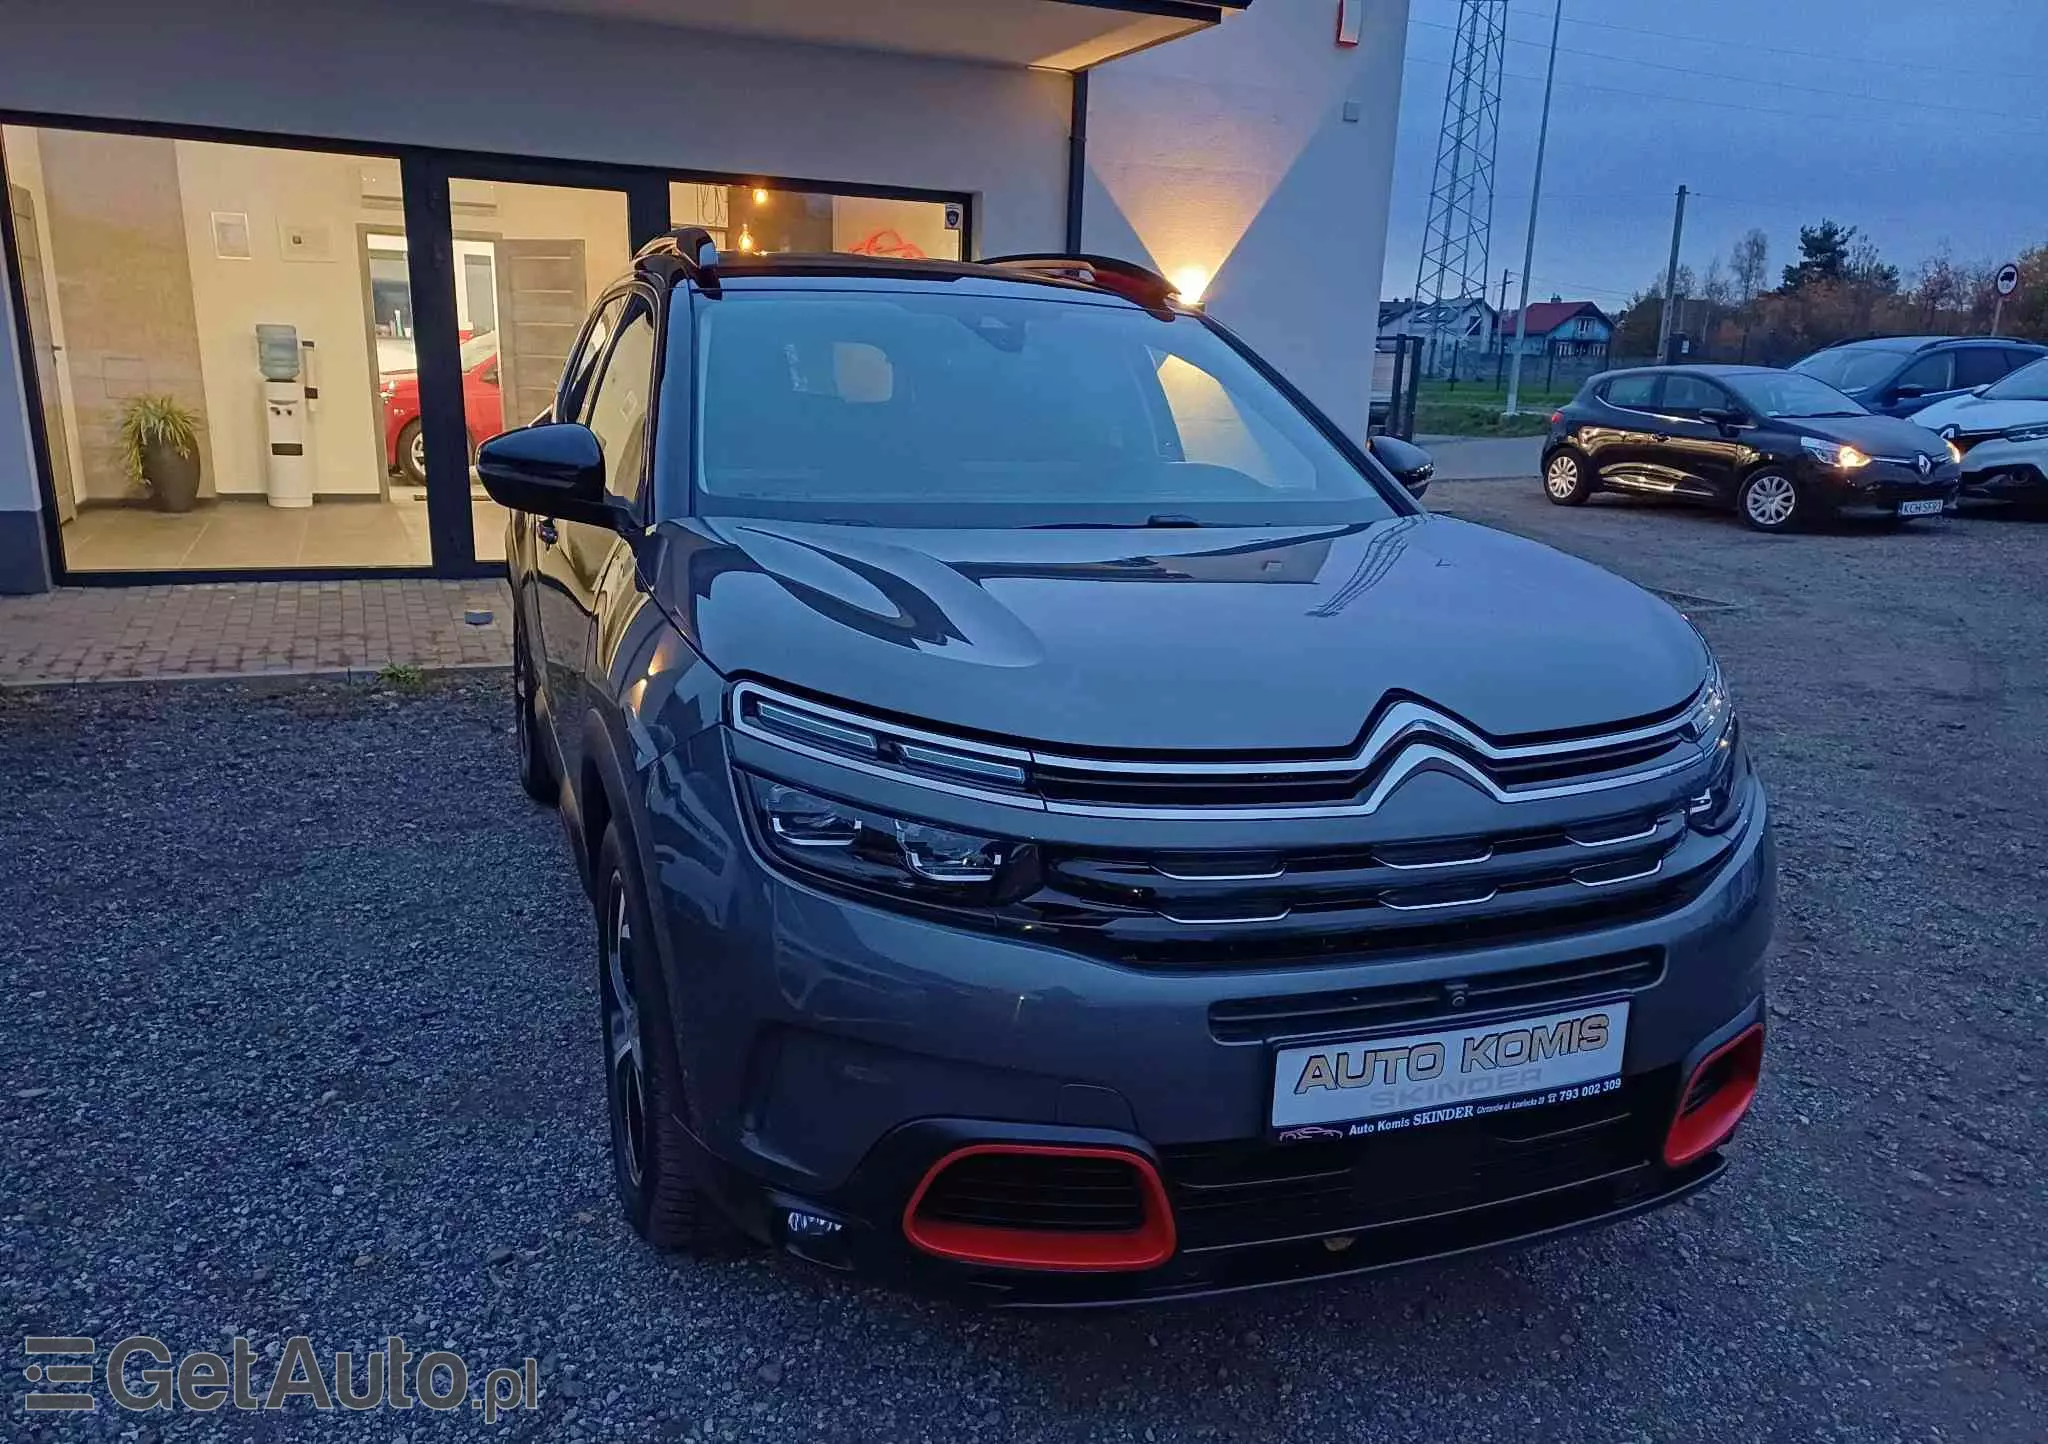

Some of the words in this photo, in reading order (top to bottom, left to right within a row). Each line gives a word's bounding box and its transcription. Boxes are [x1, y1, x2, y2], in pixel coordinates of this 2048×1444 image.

[1293, 1041, 1446, 1095] AUTO
[1460, 1013, 1610, 1073] KOMIS
[1349, 1124, 1375, 1136] Auto
[1377, 1116, 1410, 1133] Komis
[1412, 1105, 1474, 1127] SKINDER
[1559, 1089, 1579, 1102] 793
[1581, 1083, 1601, 1097] 002
[1602, 1077, 1622, 1092] 309
[1370, 1067, 1543, 1110] SKINDER
